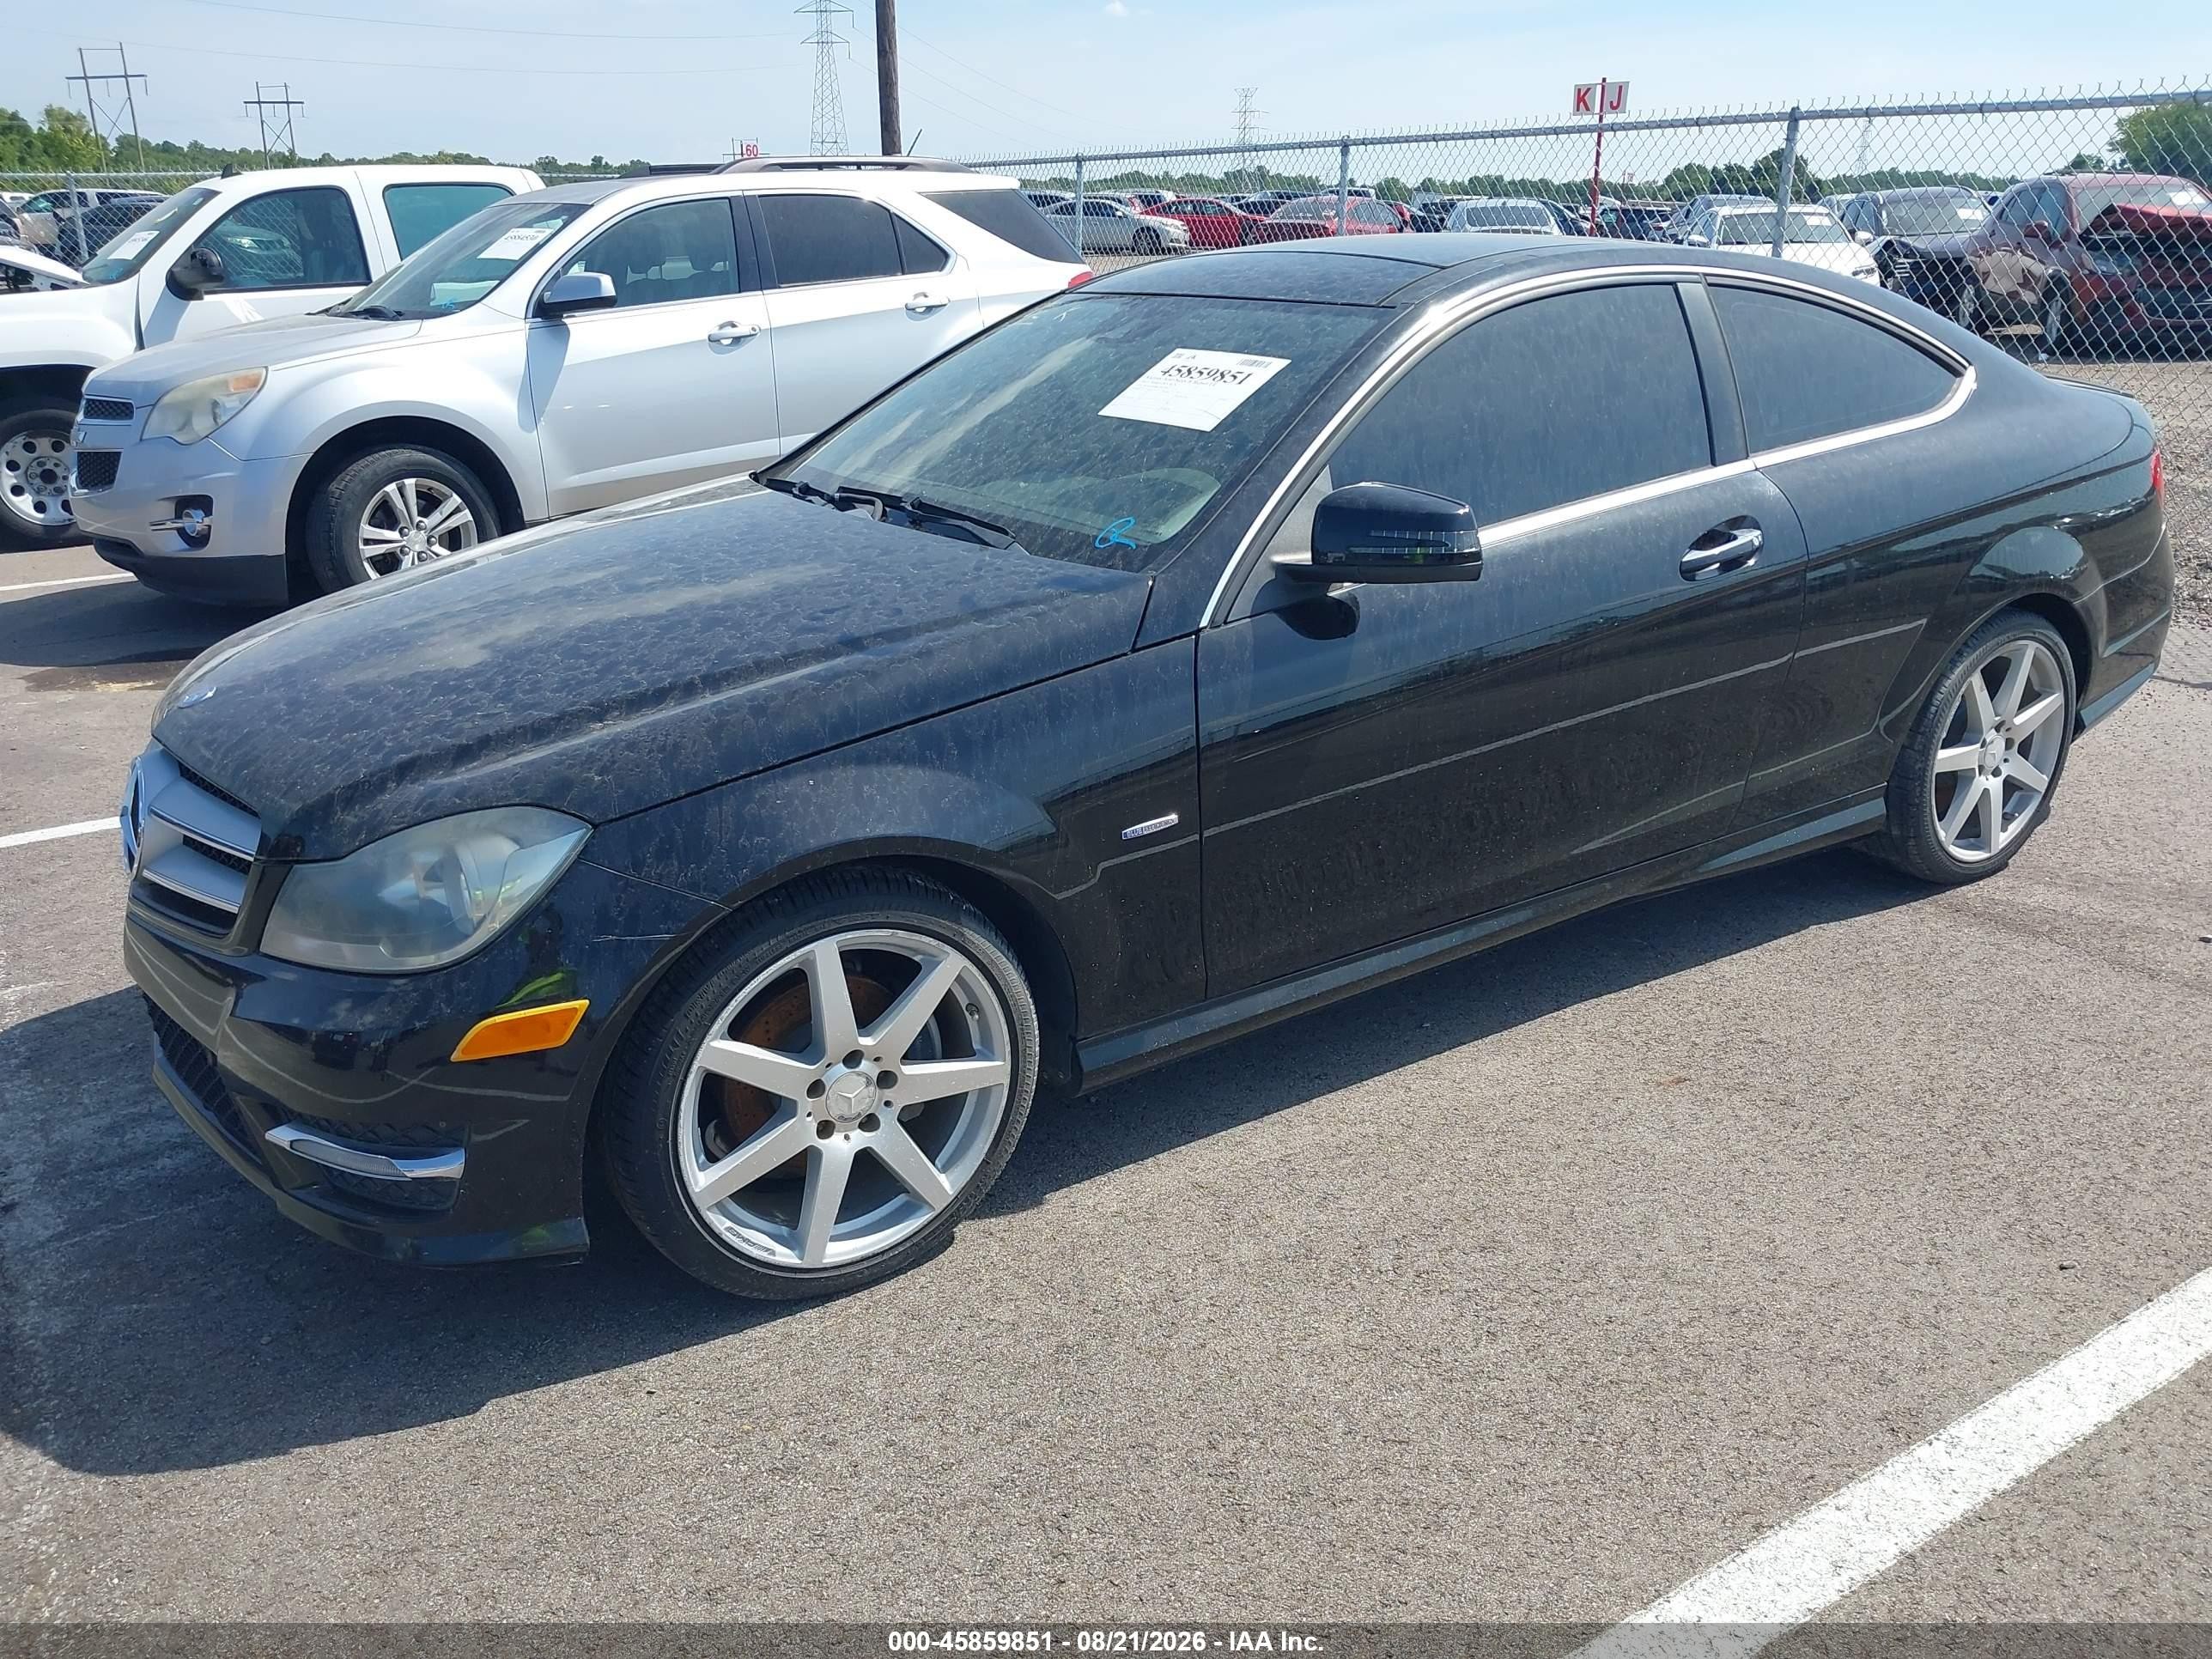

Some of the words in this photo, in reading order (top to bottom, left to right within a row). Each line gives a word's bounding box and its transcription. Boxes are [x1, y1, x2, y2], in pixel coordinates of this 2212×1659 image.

[1575, 87, 1592, 112] K
[1609, 84, 1624, 111] J
[745, 143, 759, 157] 60
[1160, 364, 1255, 386] 45859851
